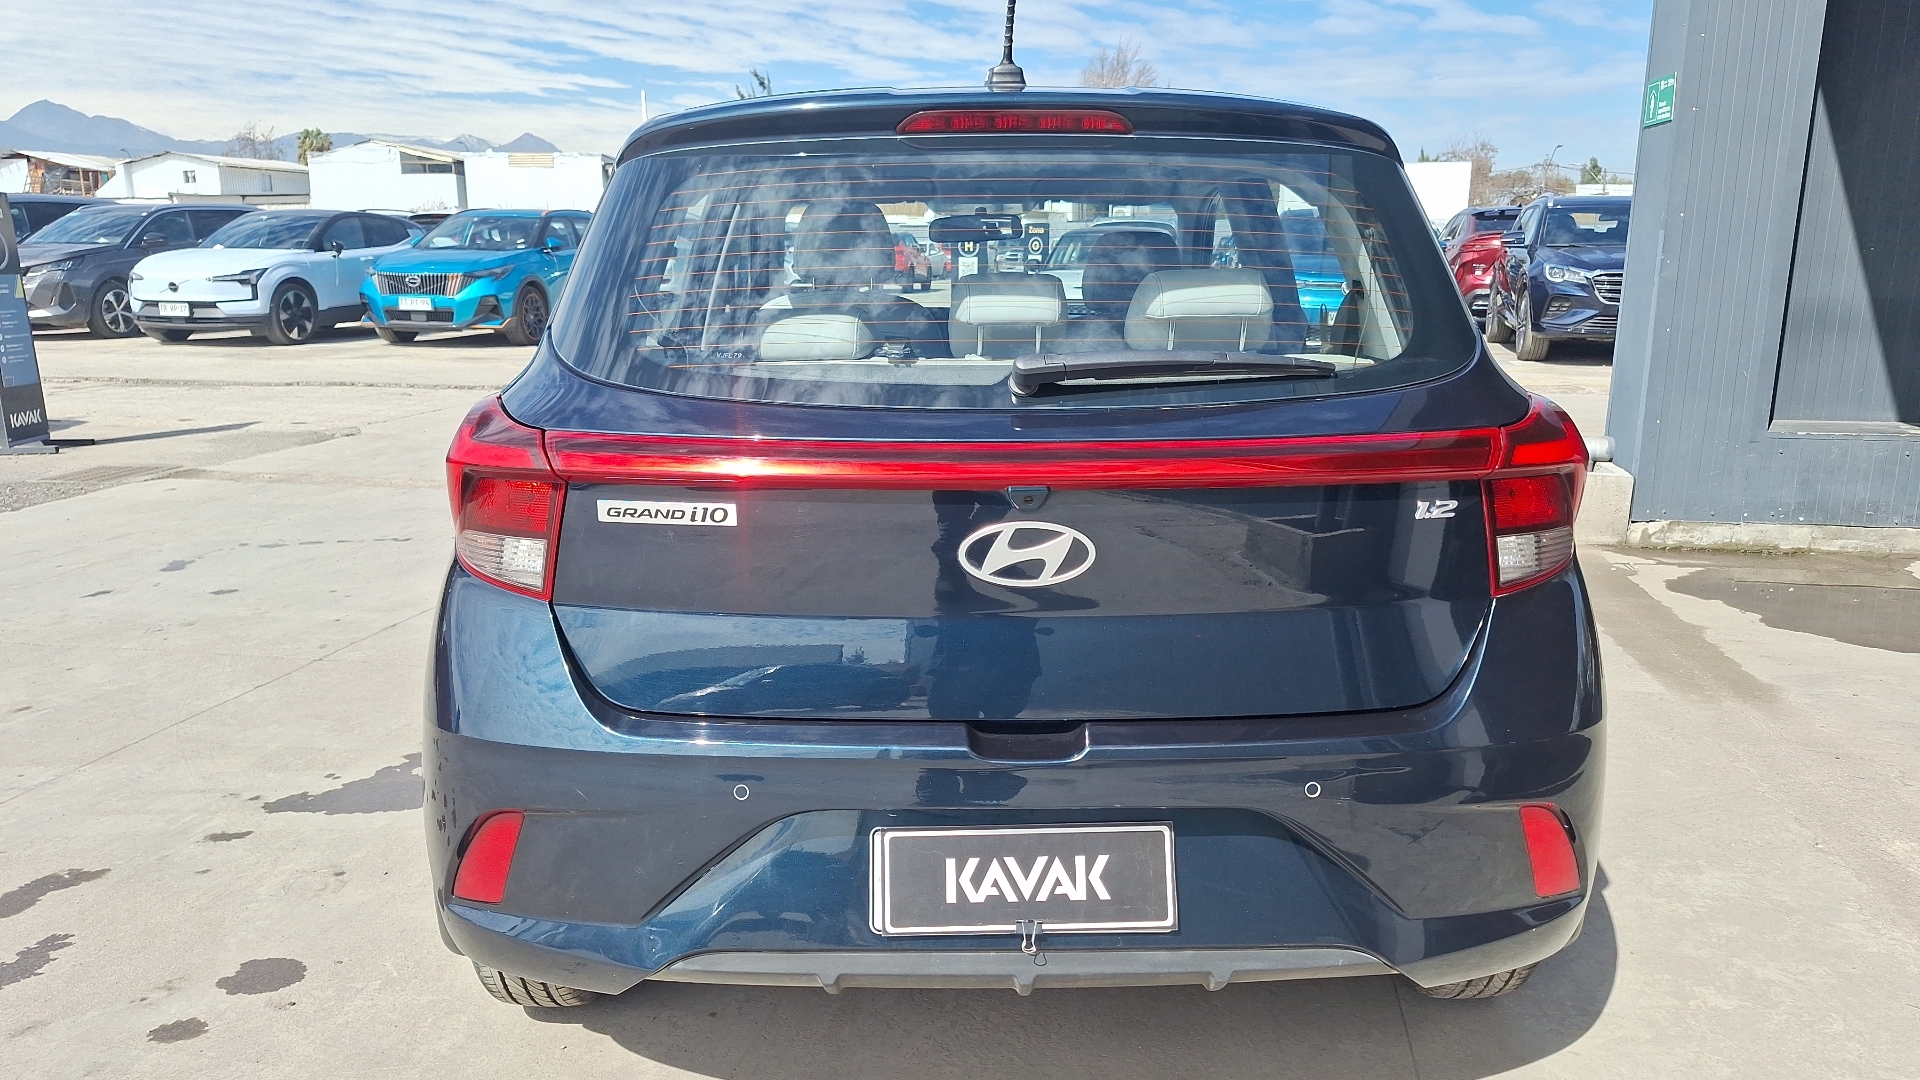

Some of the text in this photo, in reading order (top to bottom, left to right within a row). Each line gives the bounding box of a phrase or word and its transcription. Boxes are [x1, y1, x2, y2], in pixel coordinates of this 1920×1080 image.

[964, 241, 974, 252] H
[9, 408, 42, 428] KAVAK
[606, 506, 729, 524] GRAND i10
[1414, 500, 1458, 520] 1.2
[945, 854, 1112, 904] KAVAK
